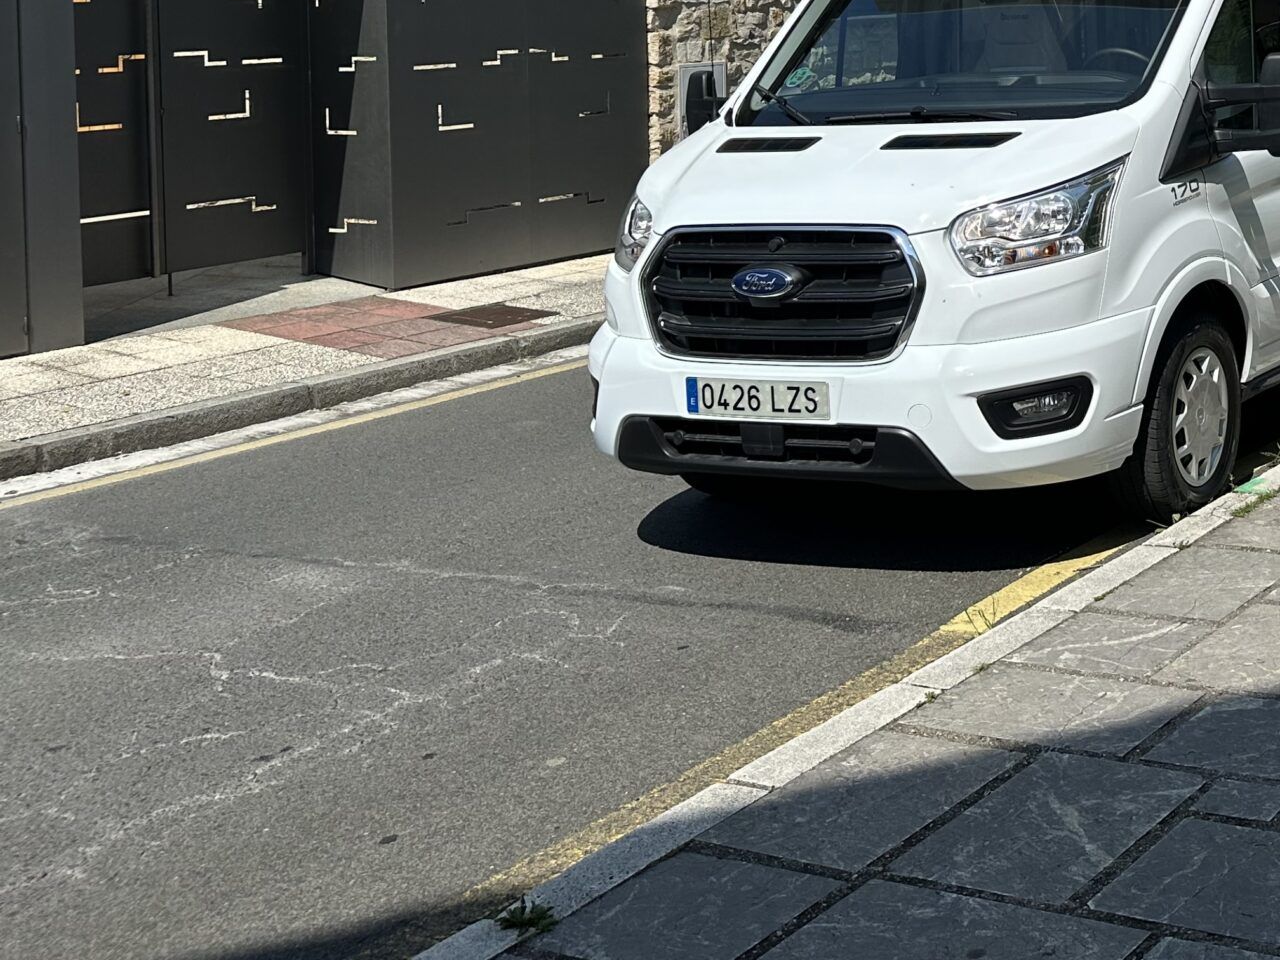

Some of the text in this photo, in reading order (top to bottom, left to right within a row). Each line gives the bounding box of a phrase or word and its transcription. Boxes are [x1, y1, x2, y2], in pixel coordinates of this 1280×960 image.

[1171, 178, 1199, 200] 170
[742, 272, 777, 290] Ford
[701, 383, 818, 414] 0426 LZS
